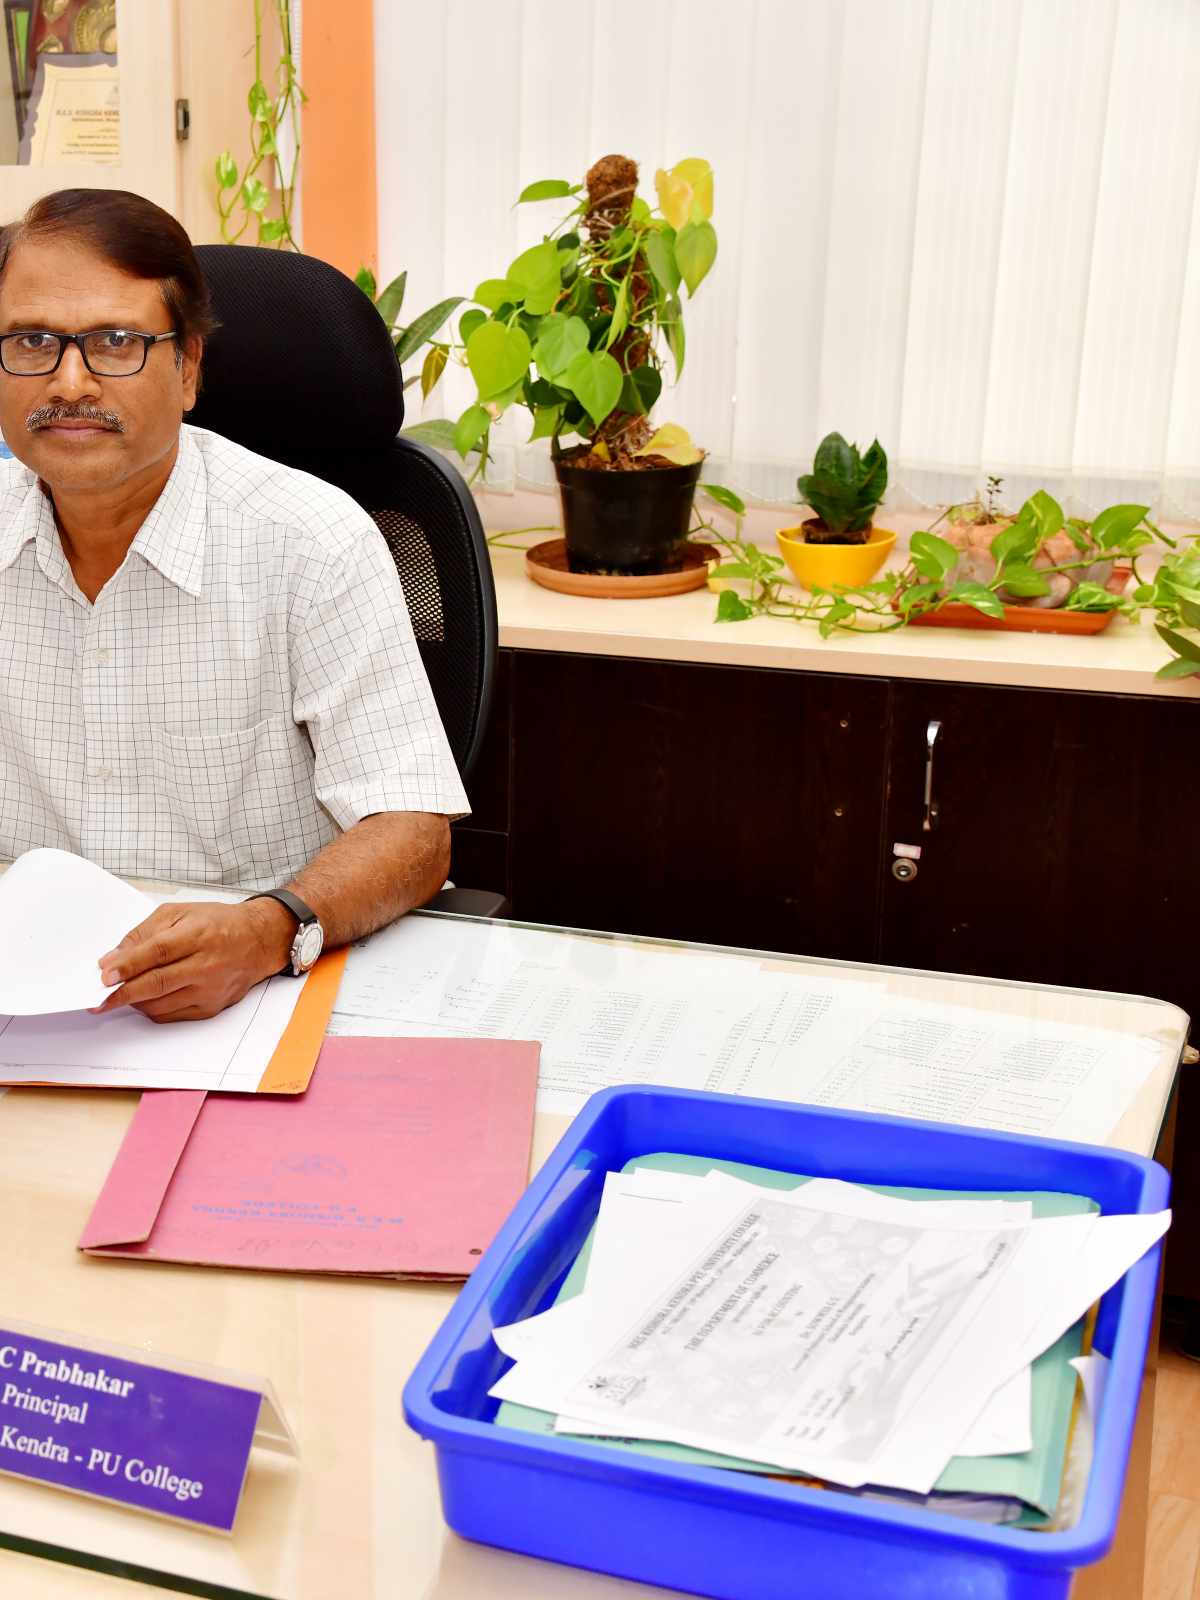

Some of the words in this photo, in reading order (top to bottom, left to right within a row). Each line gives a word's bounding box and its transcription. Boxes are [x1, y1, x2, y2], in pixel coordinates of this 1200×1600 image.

[19, 1350, 134, 1398] Prabhakar
[0, 1382, 89, 1424] Principal
[0, 1425, 70, 1464] Kendra
[87, 1448, 122, 1476] PU
[124, 1458, 205, 1501] College
